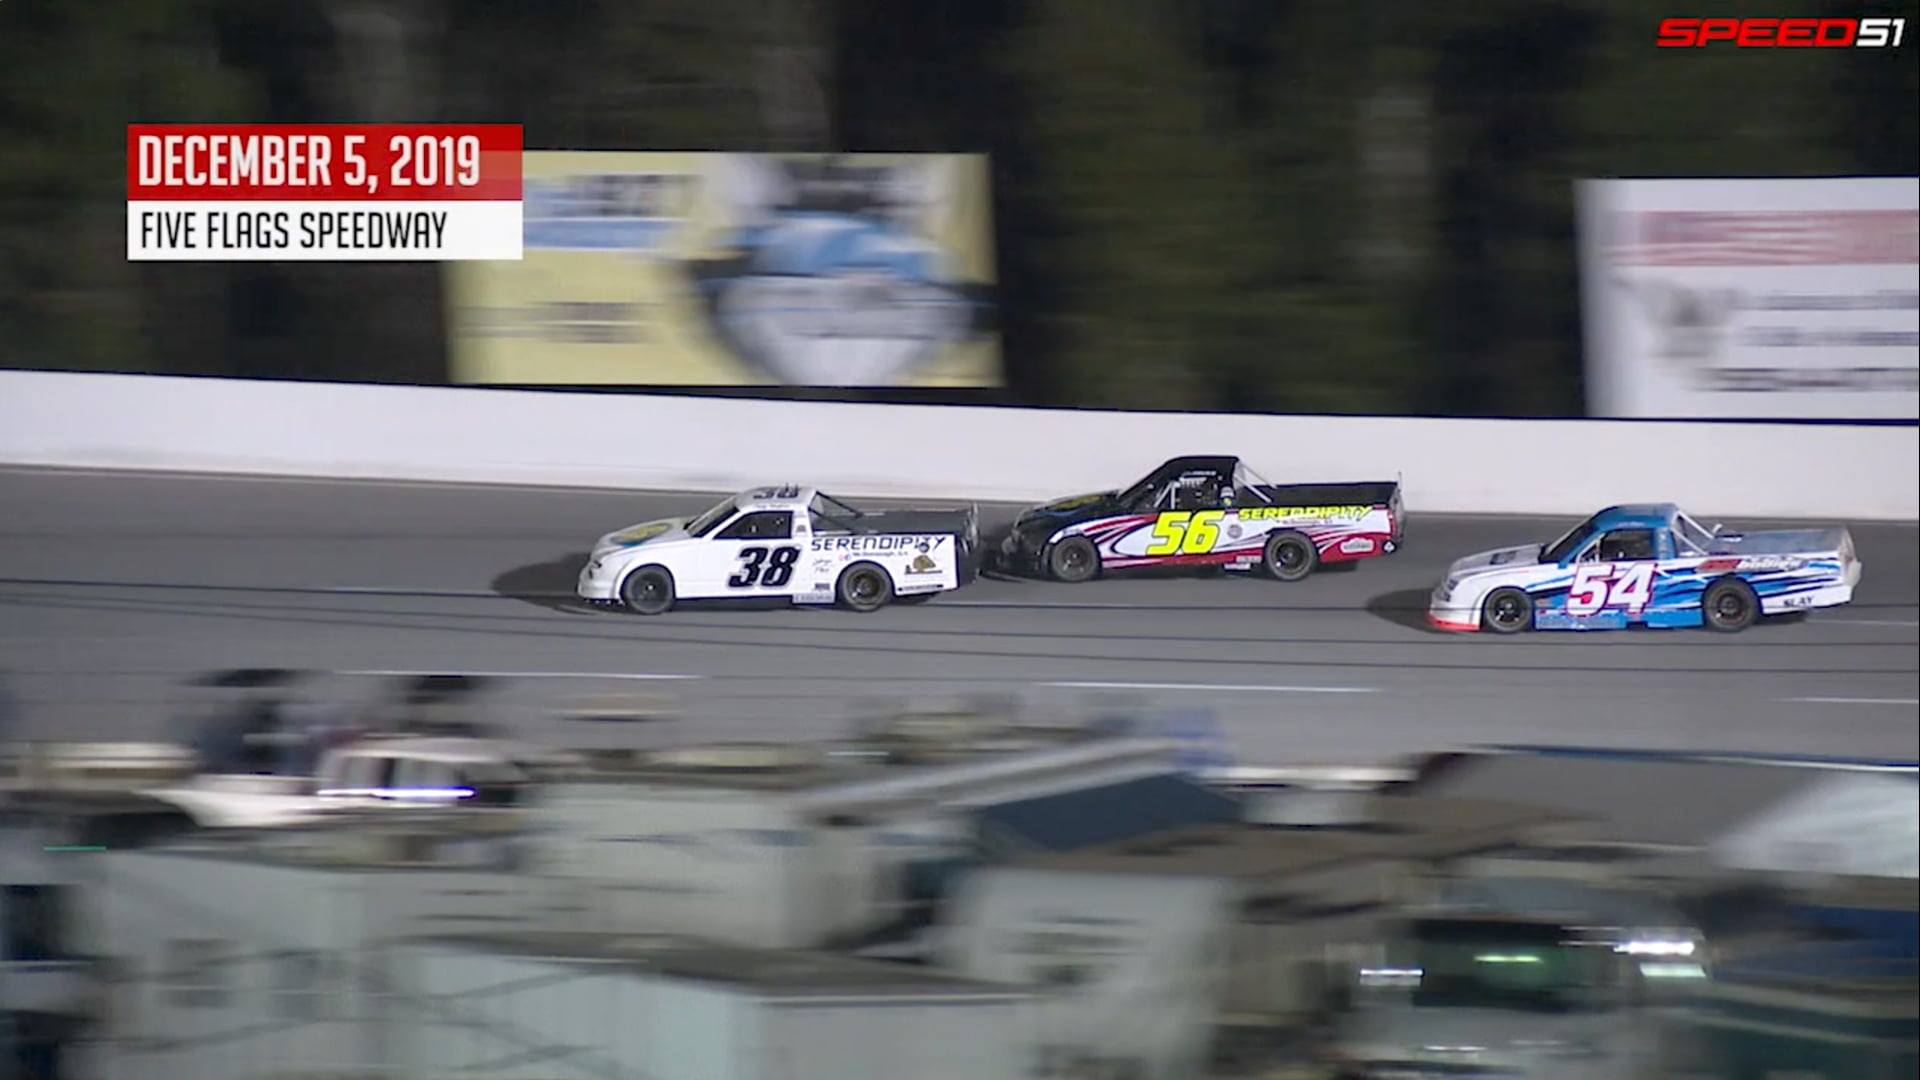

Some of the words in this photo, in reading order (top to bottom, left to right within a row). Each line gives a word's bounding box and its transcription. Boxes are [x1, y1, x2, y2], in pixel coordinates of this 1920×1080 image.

[1146, 510, 1226, 556] 56
[1238, 505, 1373, 521] SERENDIPITY
[811, 536, 946, 551] SERENDIPITY
[728, 546, 800, 588] 38
[1565, 562, 1658, 618] 54
